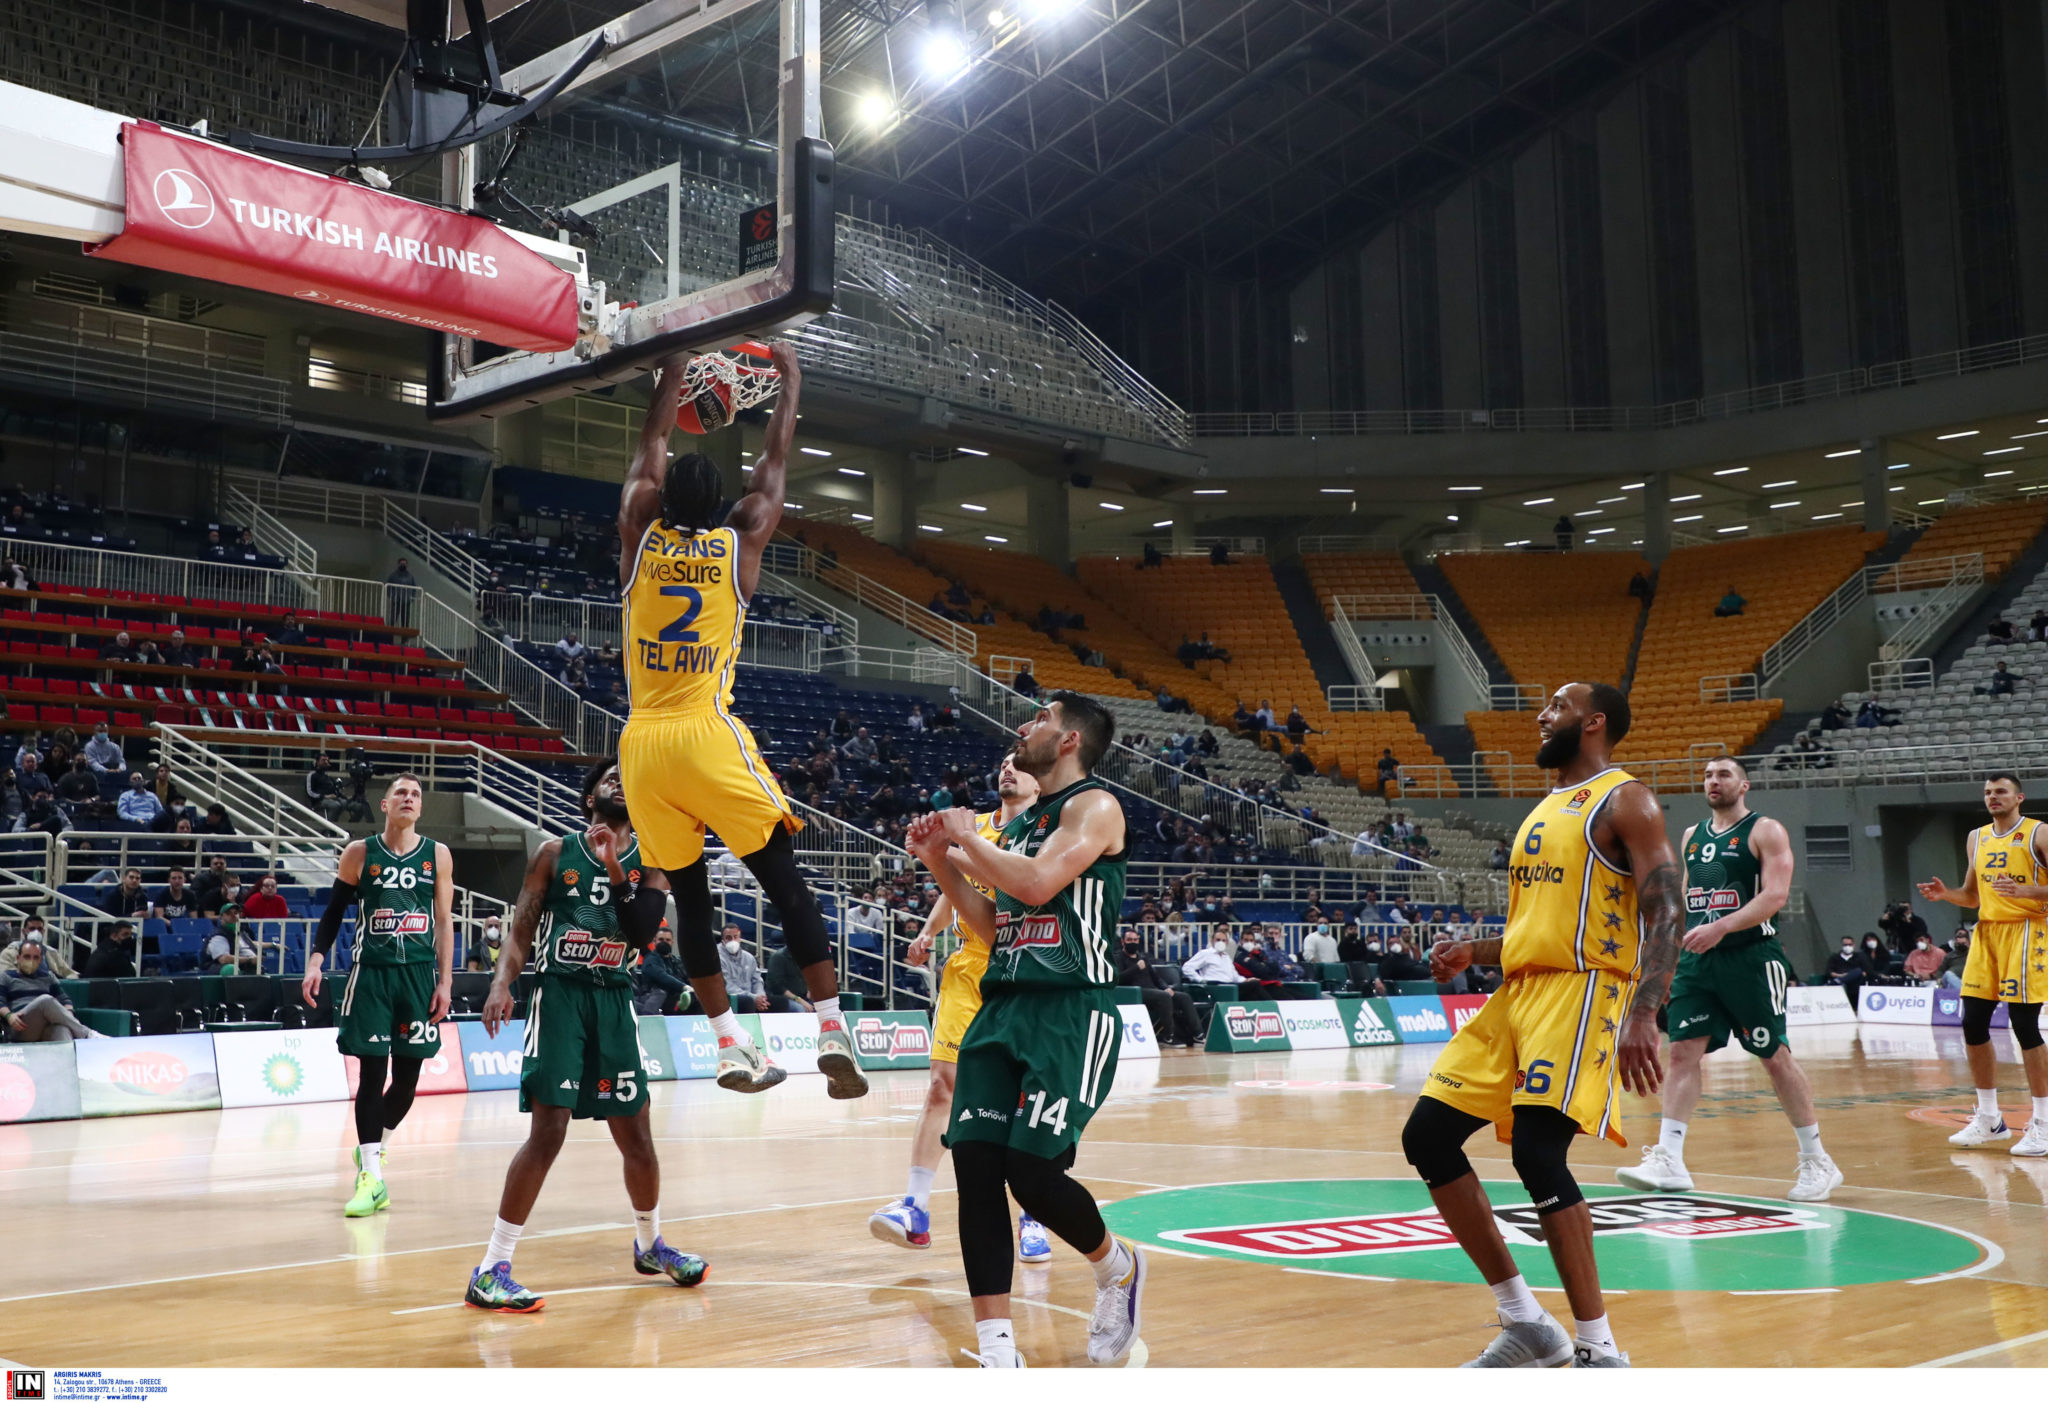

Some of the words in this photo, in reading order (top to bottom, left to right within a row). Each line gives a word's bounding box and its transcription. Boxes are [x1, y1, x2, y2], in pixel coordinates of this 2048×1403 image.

[229, 198, 364, 251] TURKISH
[374, 231, 499, 278] AIRLINES
[334, 298, 406, 319] TURKISH
[407, 315, 480, 336] AIRLINES
[644, 531, 726, 558] EVANS
[643, 560, 722, 584] weSure
[658, 585, 702, 643] 2
[638, 638, 668, 672] TEL
[674, 645, 720, 673] AVIV
[1524, 821, 1545, 855] 6
[1701, 842, 1716, 863] 9
[1985, 851, 2008, 869] 23
[382, 866, 417, 889] 26
[589, 876, 611, 905] 5
[408, 1020, 438, 1044] 26
[1296, 1019, 1342, 1030] COSMOTE
[1397, 1009, 1448, 1032] molto
[284, 1036, 301, 1049] bp
[785, 1036, 818, 1050] COSM
[1354, 1028, 1395, 1043] adidas
[1752, 1026, 1770, 1048] 9
[681, 1037, 719, 1058] Ton
[115, 1062, 185, 1085] NIKAS
[1434, 1072, 1463, 1089] Rapyd
[1525, 1059, 1555, 1094] 6
[615, 1070, 638, 1102] 5
[1028, 1090, 1069, 1136] 14
